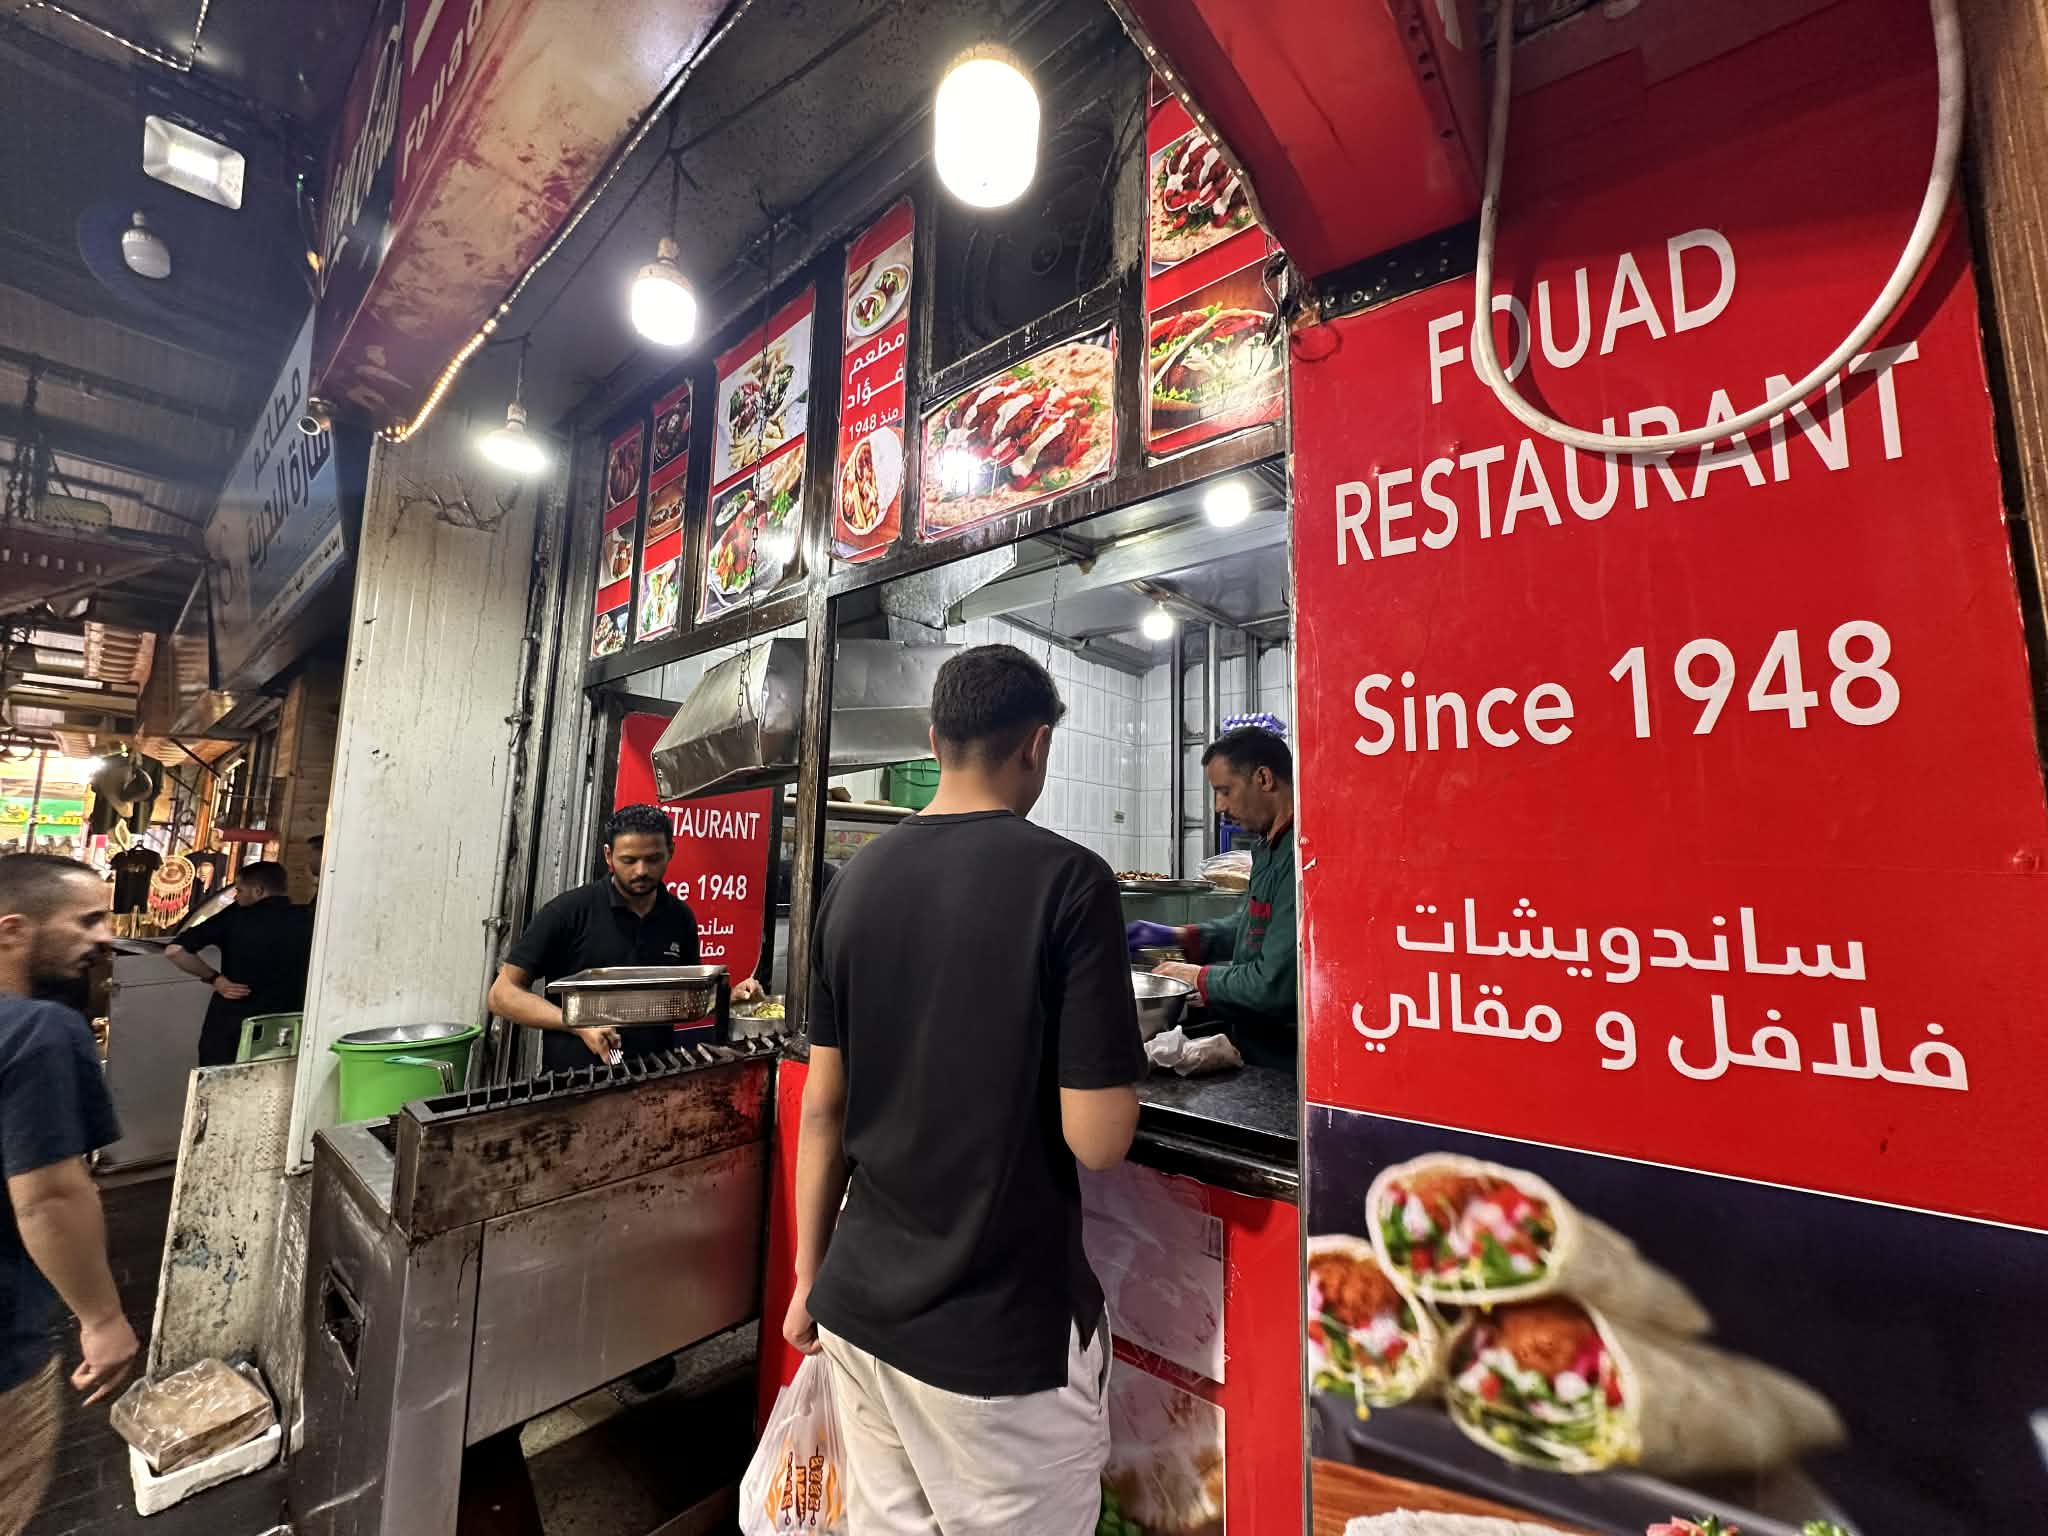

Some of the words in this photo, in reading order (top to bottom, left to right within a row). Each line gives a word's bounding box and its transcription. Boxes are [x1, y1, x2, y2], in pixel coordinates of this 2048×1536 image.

[1428, 228, 1736, 404] FOUAD
[846, 362, 904, 410] فؤاد
[848, 332, 905, 385] مطعم
[253, 367, 301, 492] مطاعم
[848, 413, 877, 441] 1948
[880, 407, 899, 425] منذ
[1335, 341, 1919, 565] RESTAURANT
[1353, 672, 1575, 757] Since
[1609, 620, 1901, 739] 1948
[661, 805, 760, 840] TAURANT
[698, 874, 748, 900] 1948
[1395, 897, 1867, 984] ساندويشات
[1350, 971, 1563, 1054] مقالي
[1594, 1010, 1638, 1071] و
[1667, 994, 1970, 1092] فلافل
